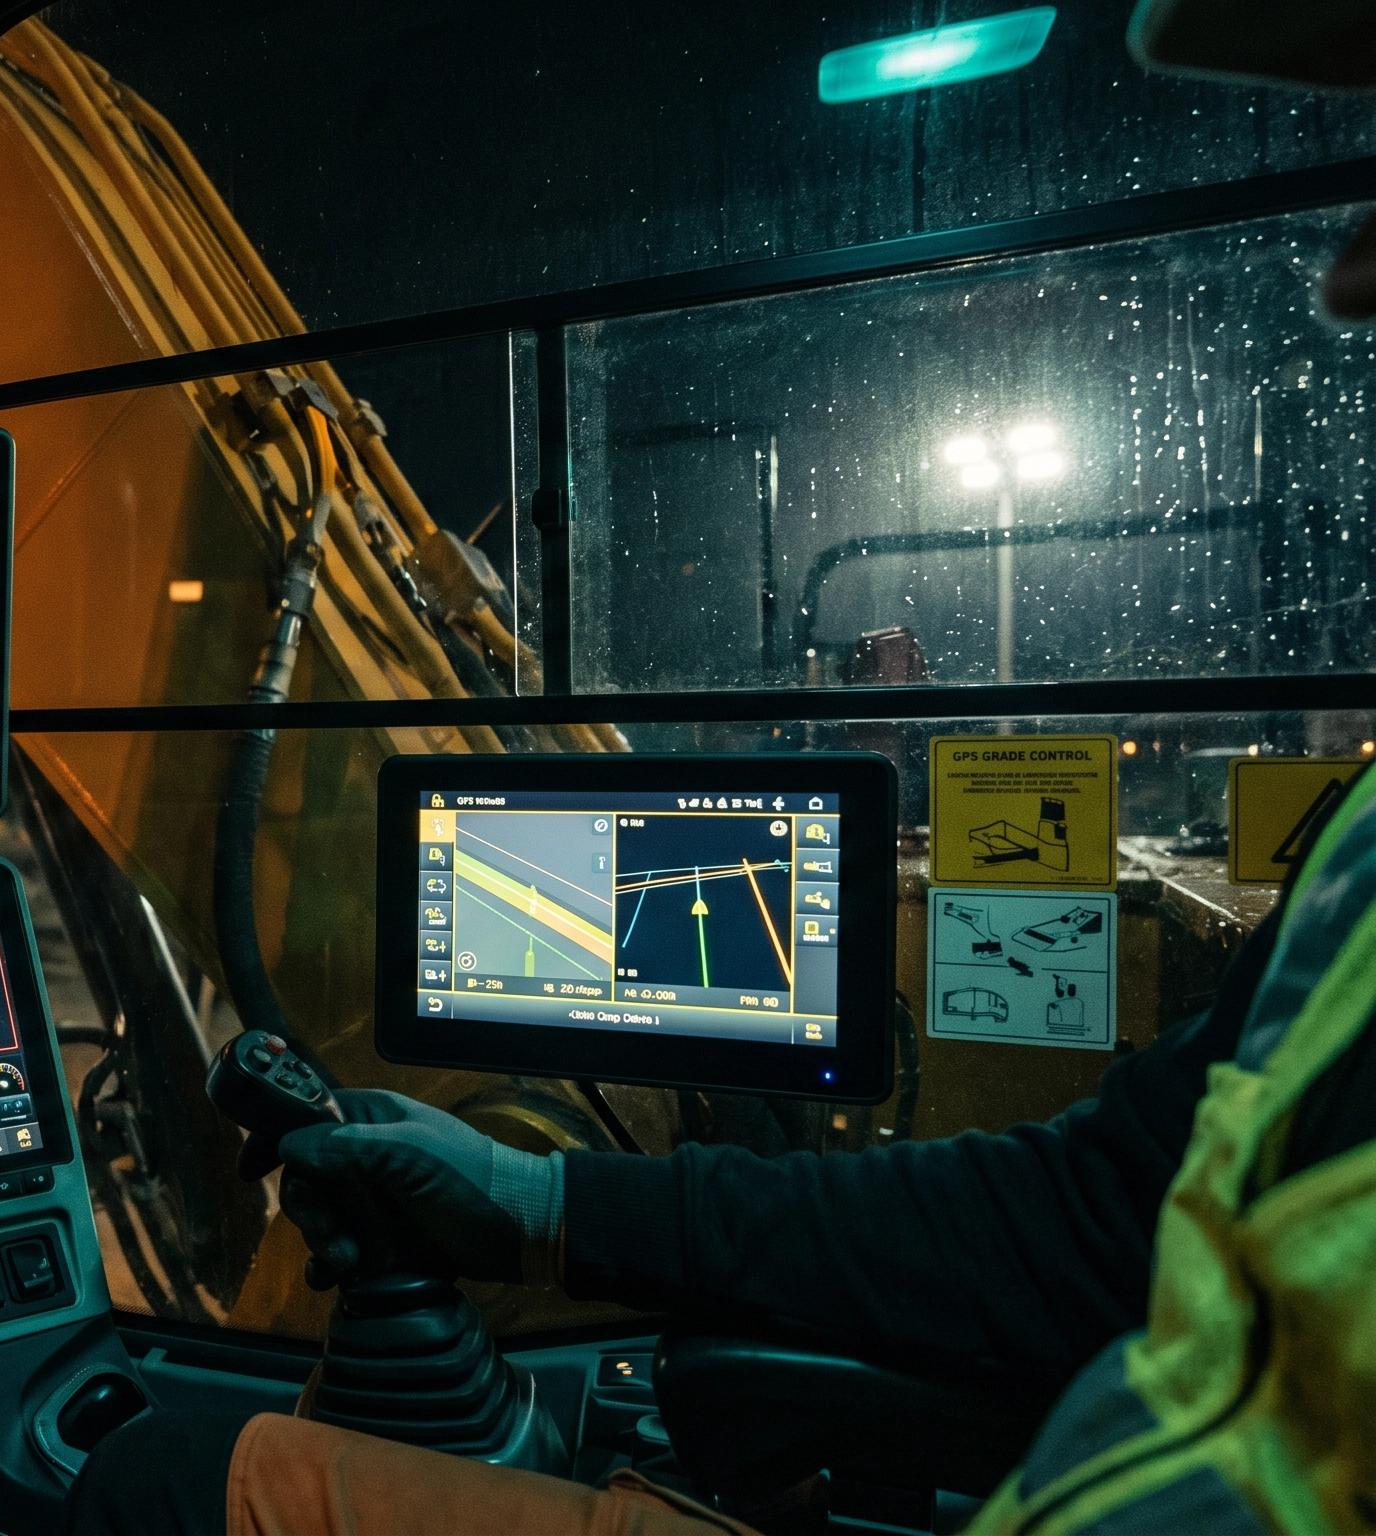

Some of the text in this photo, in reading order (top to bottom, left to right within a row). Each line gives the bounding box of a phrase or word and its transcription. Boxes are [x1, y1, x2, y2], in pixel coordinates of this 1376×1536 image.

[953, 750, 1092, 761] GPS GRADE CONTROL
